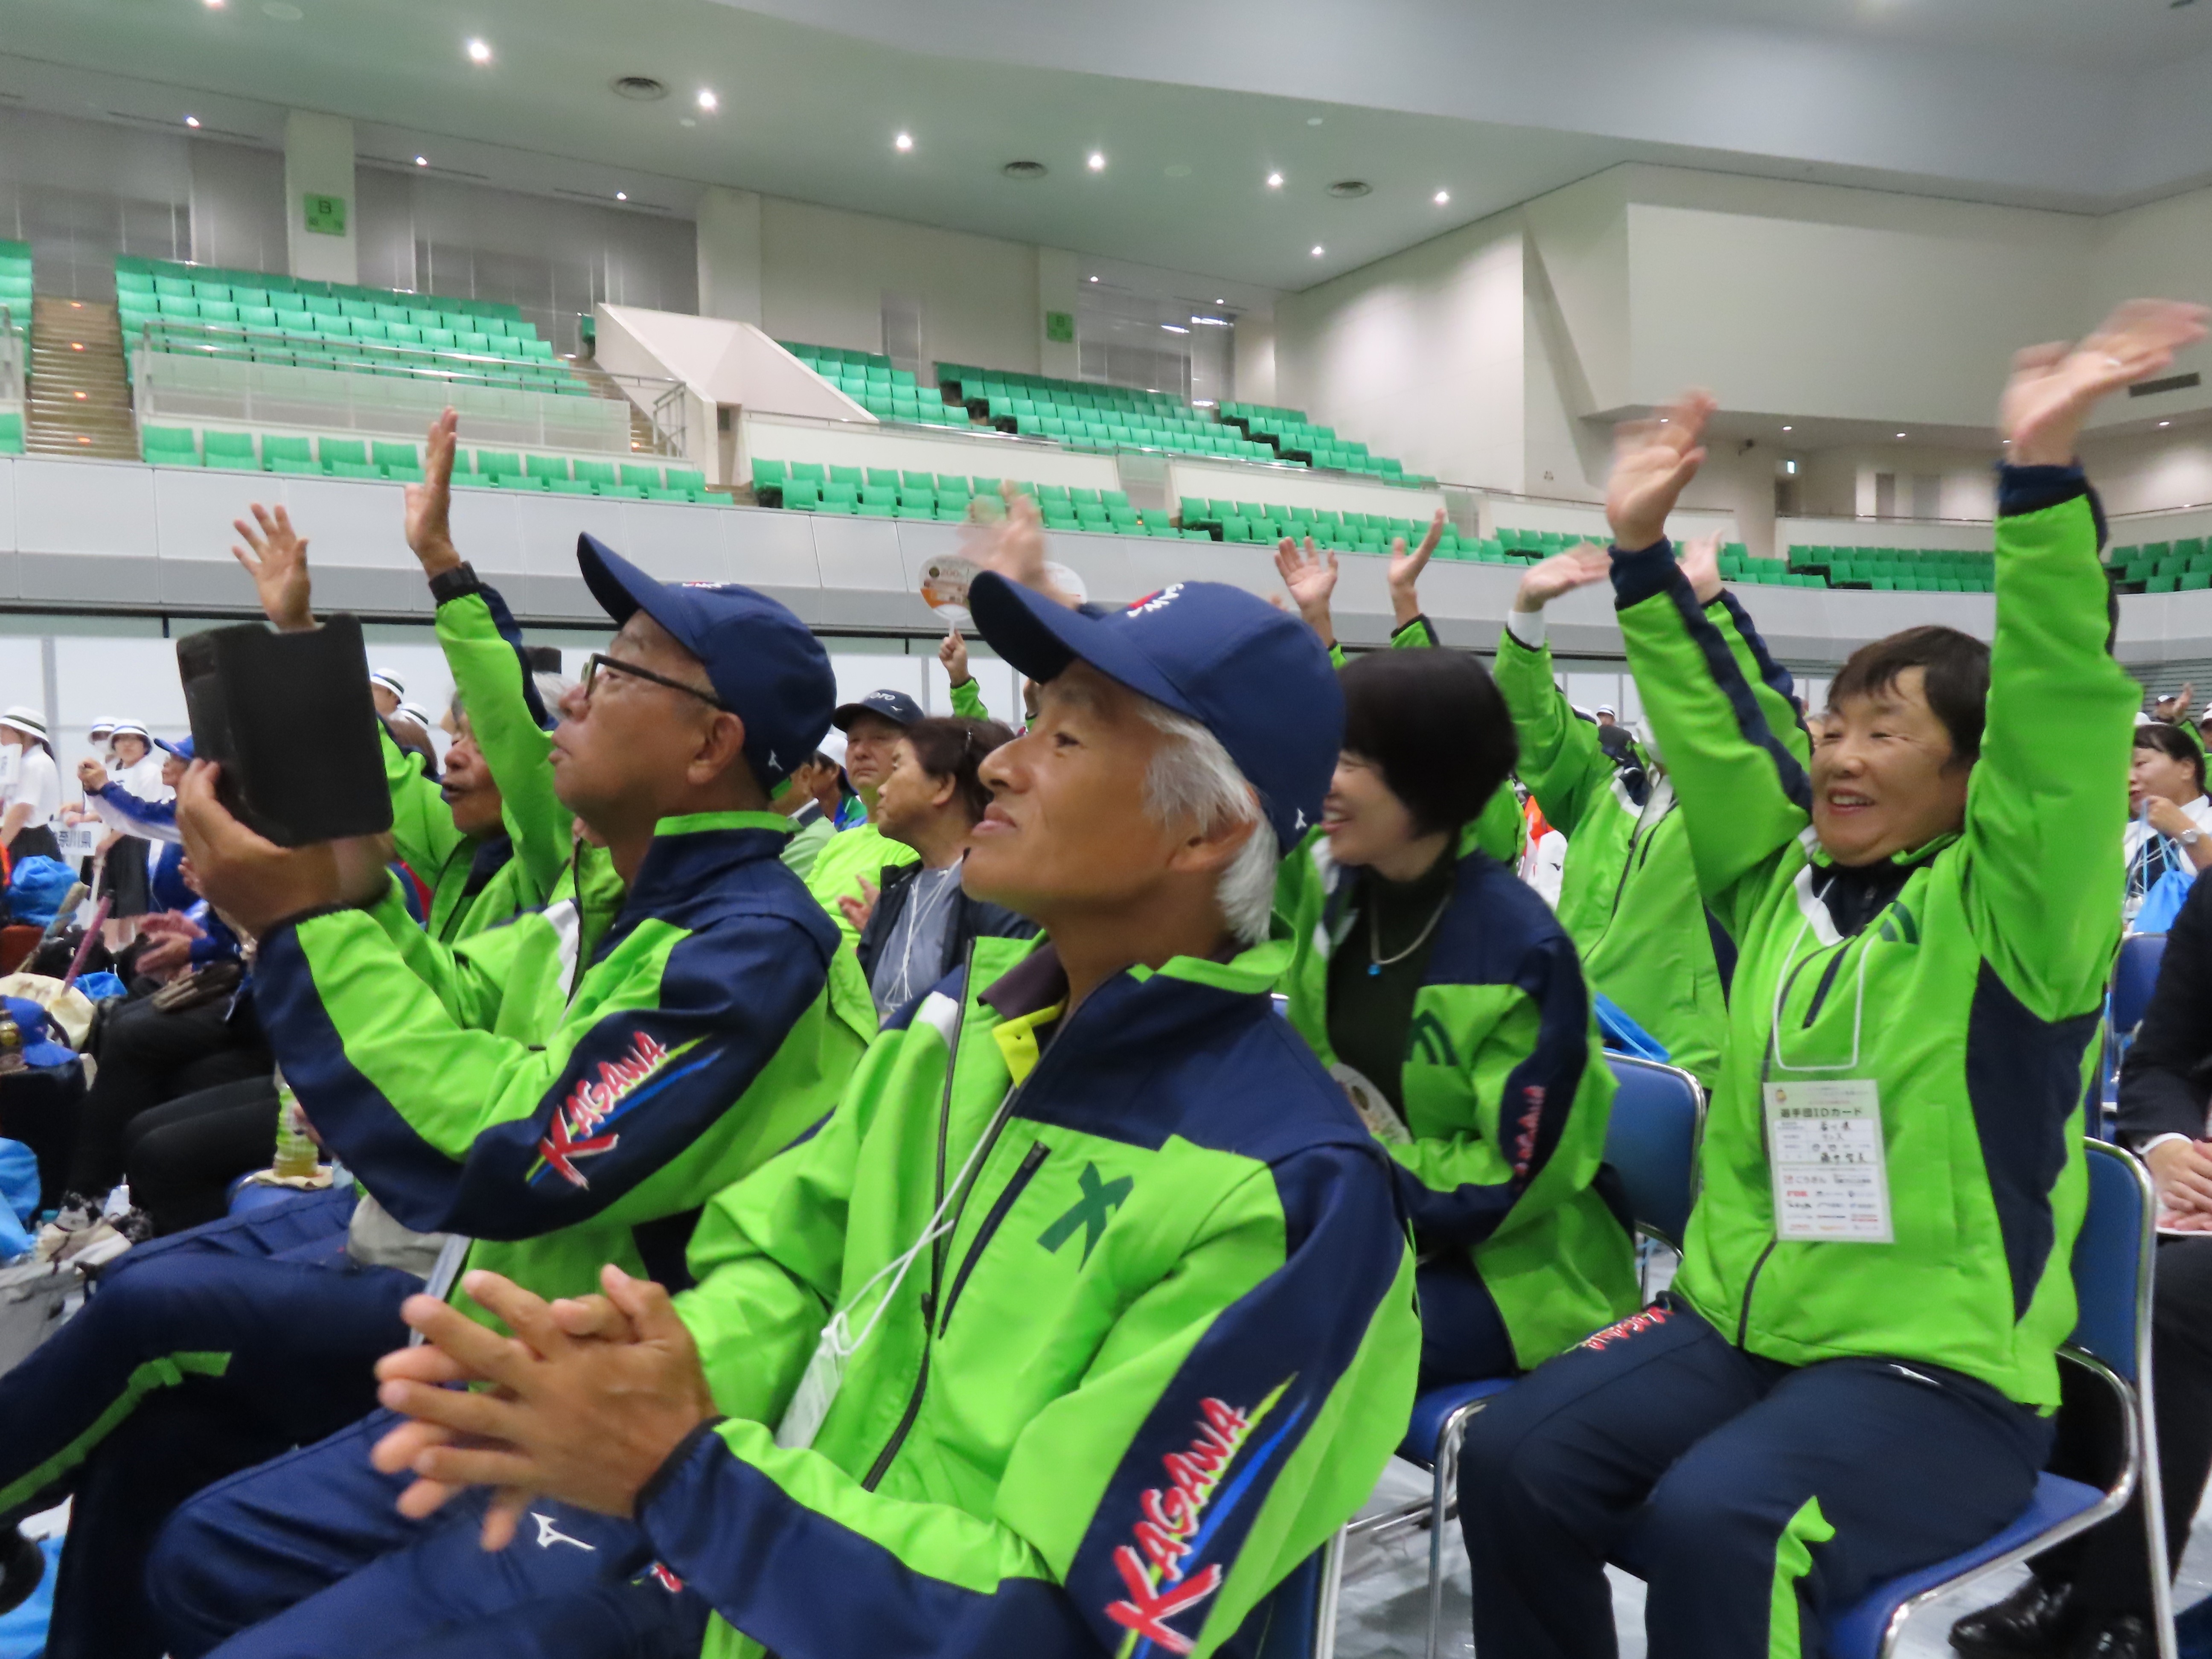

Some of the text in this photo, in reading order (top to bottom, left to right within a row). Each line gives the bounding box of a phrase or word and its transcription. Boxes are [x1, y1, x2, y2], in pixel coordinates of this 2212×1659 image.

[318, 200, 332, 214] B
[54, 831, 91, 848] 奈川県
[538, 1030, 668, 1190] KAGAWA
[1105, 1397, 1252, 1655] KAGAWA
